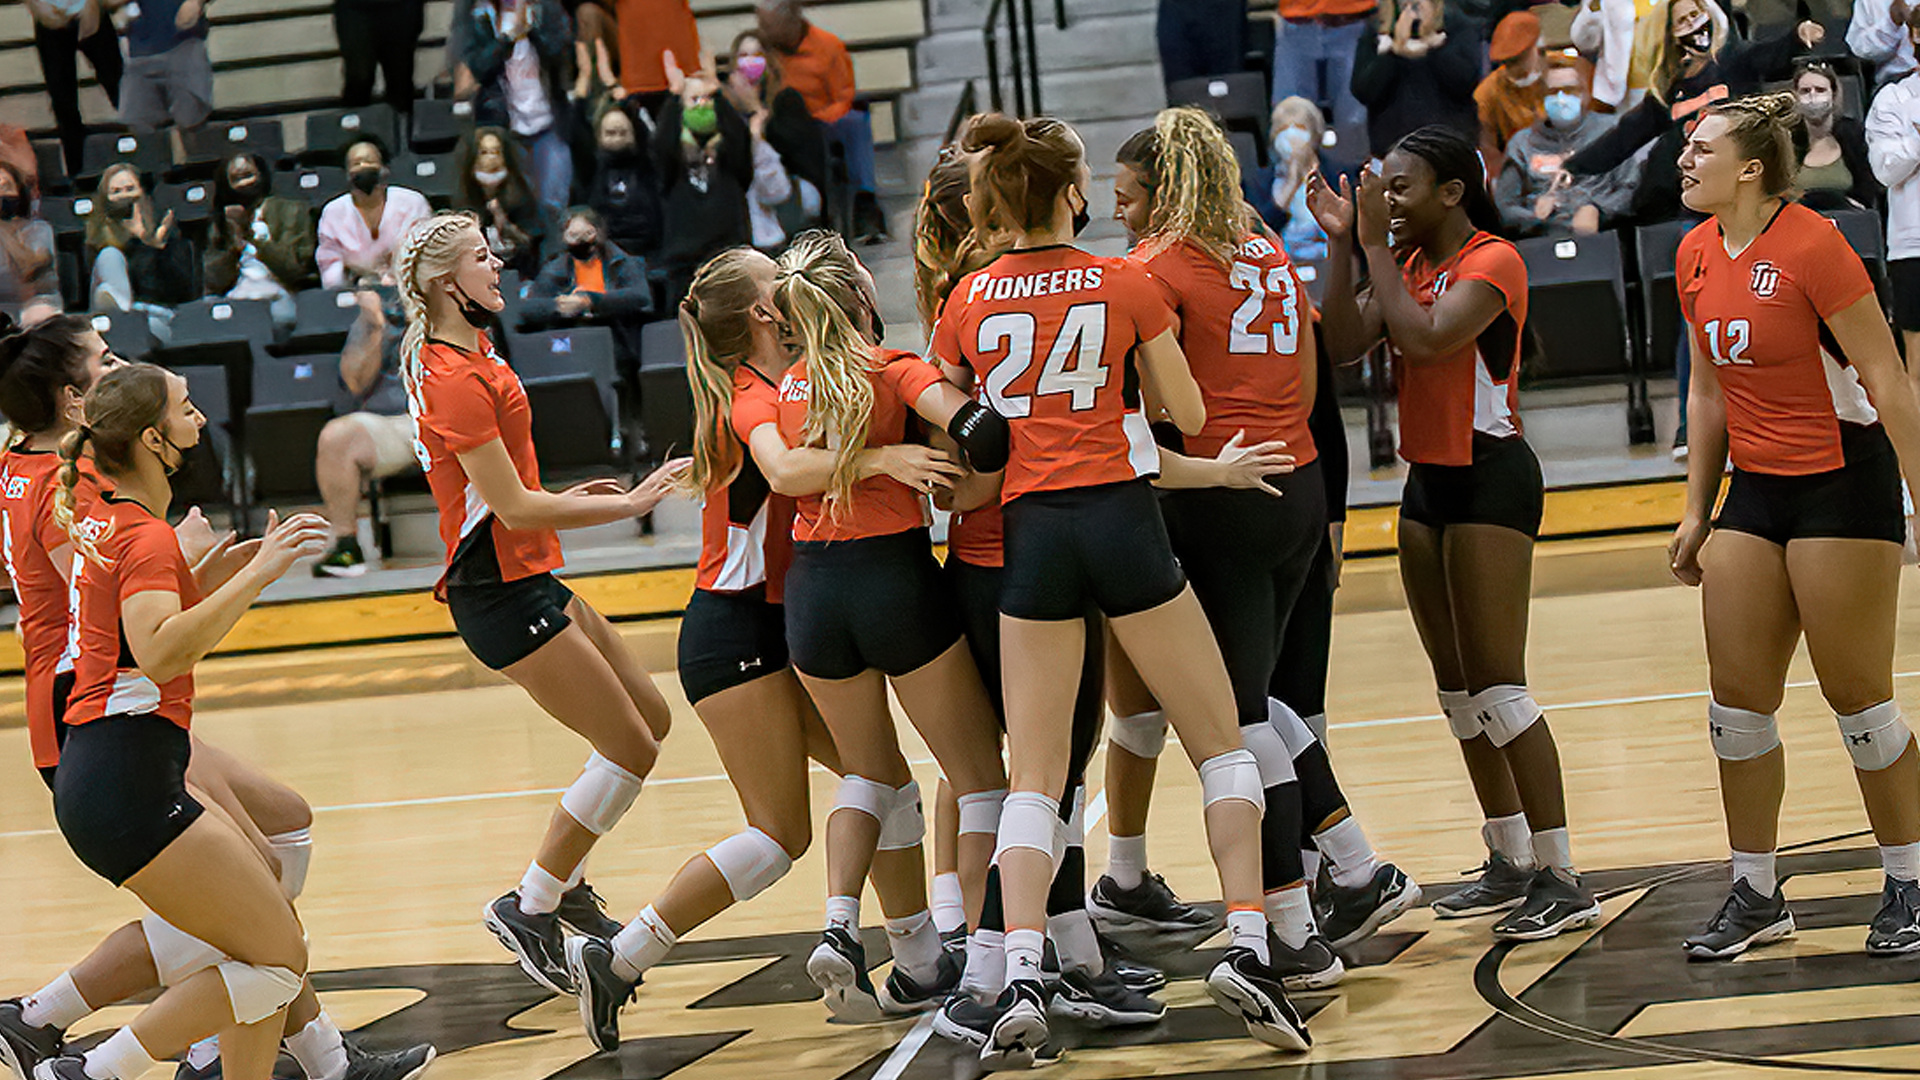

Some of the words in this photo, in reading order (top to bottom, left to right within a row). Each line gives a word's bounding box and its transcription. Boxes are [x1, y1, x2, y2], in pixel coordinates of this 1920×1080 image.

[967, 267, 1104, 304] PIONEERS
[1749, 260, 1781, 299] TU
[1229, 260, 1299, 354] 23
[978, 301, 1110, 419] 24
[1703, 318, 1755, 366] 12
